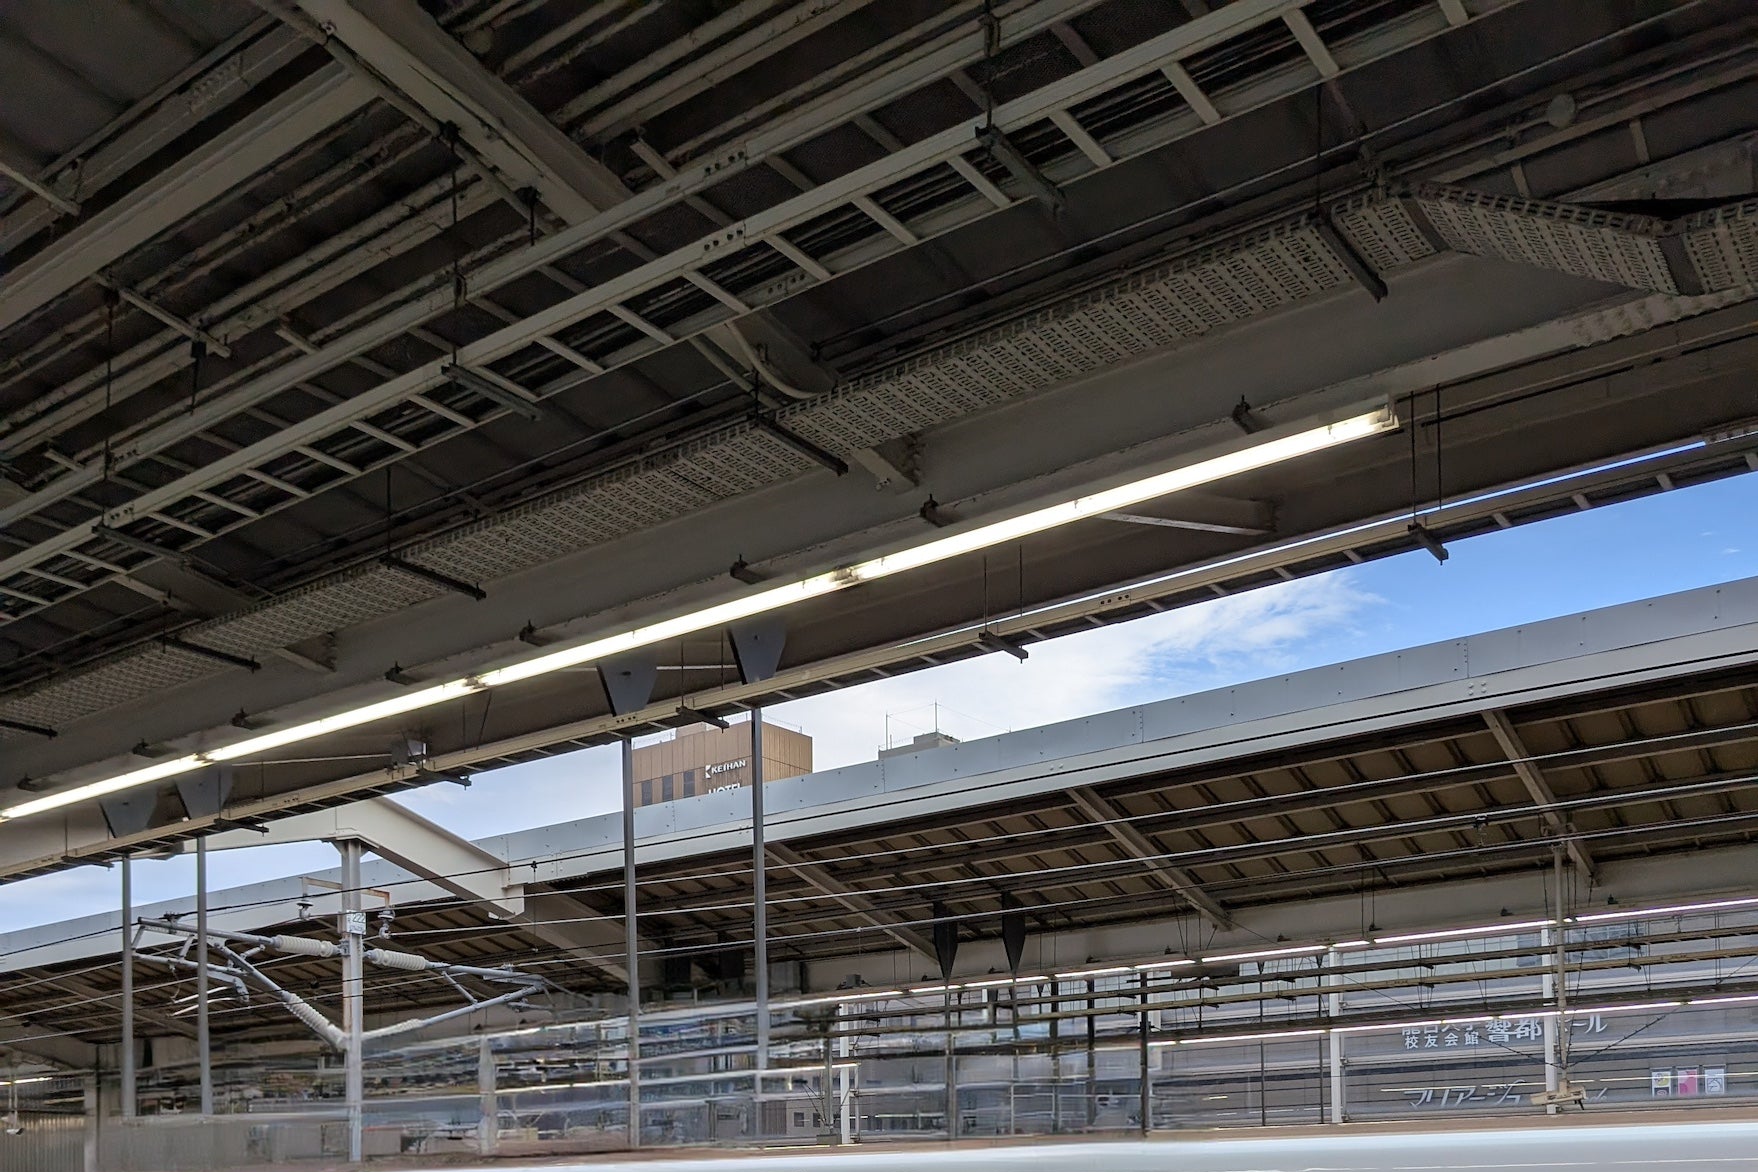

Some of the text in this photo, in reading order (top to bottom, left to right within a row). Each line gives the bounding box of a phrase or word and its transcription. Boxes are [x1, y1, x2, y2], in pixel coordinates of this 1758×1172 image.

[711, 759, 746, 774] KEIHAN
[1404, 1030, 1480, 1050] 校友会館
